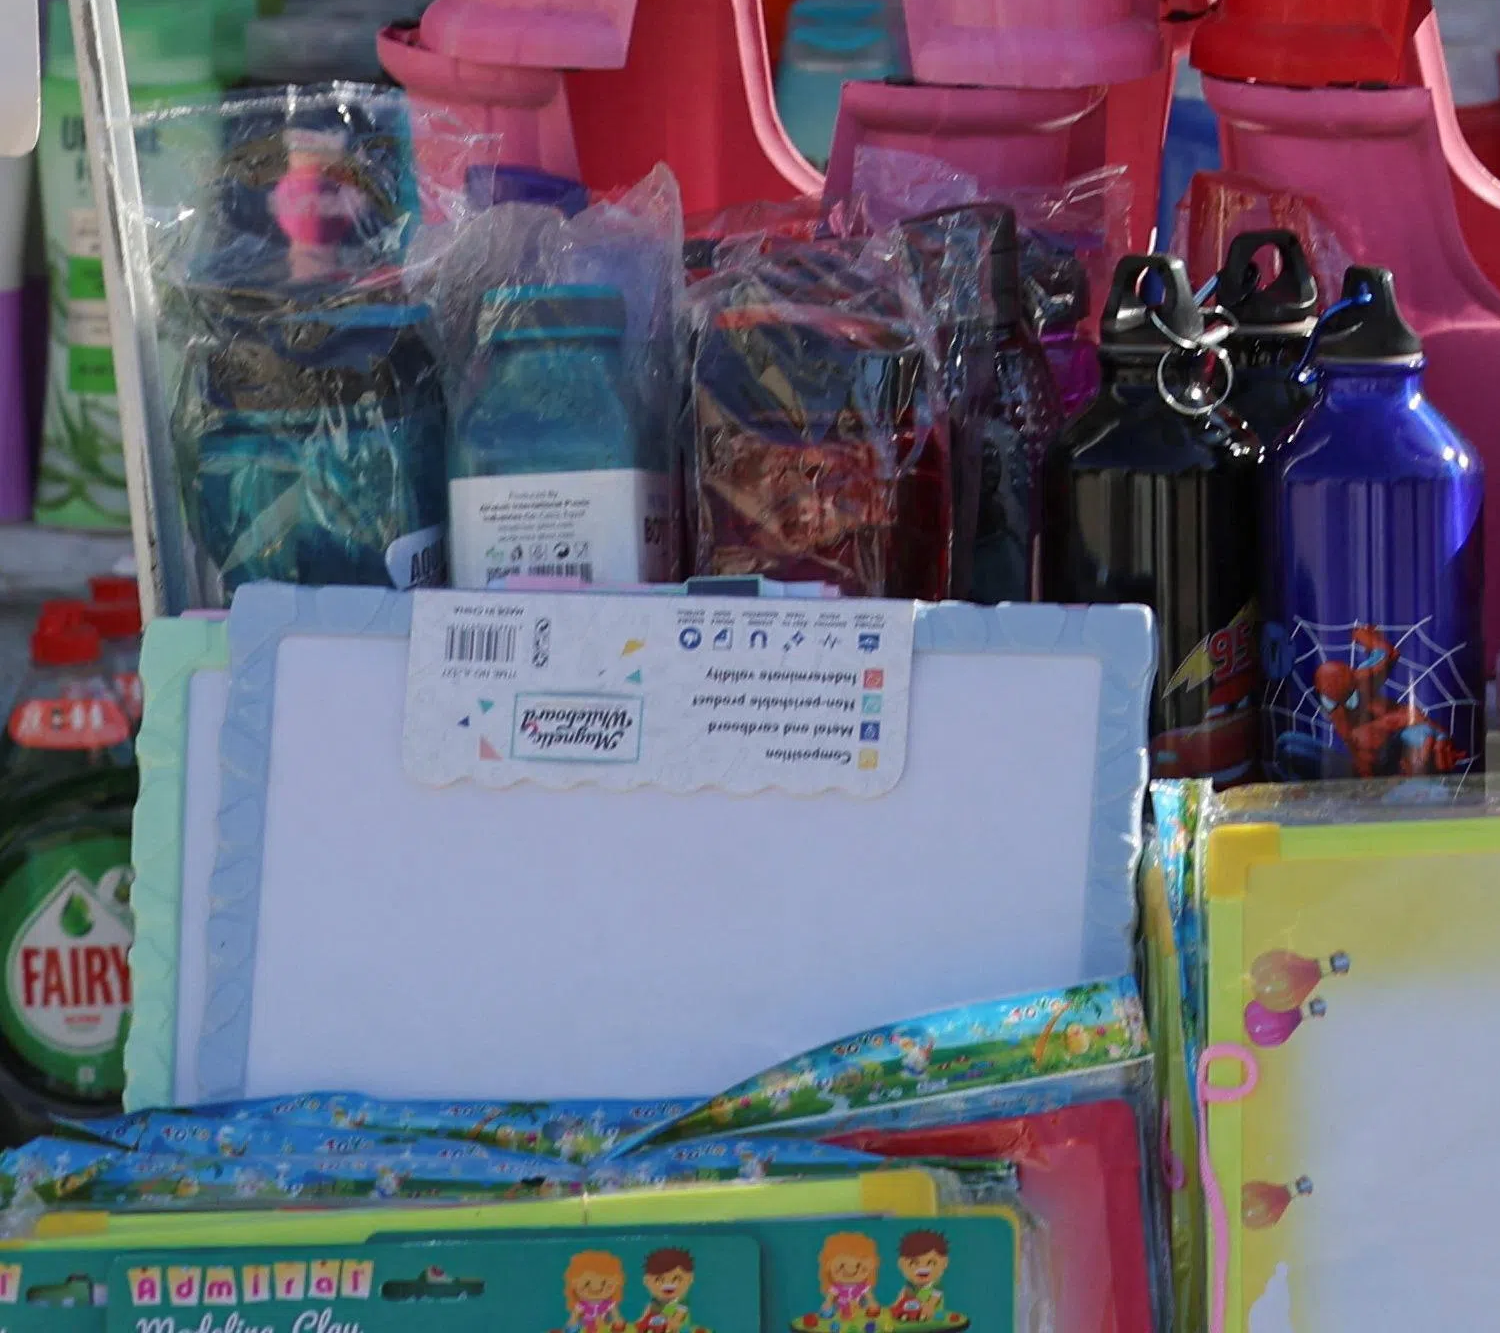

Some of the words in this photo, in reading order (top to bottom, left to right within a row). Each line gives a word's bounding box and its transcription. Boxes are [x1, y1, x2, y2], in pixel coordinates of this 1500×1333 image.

[519, 705, 635, 732] Whiteboard
[782, 722, 809, 737] and
[526, 723, 627, 753] Magnetic
[764, 748, 853, 765] Composition
[20, 944, 132, 1009] FAIRY
[135, 1267, 366, 1303] Admiral
